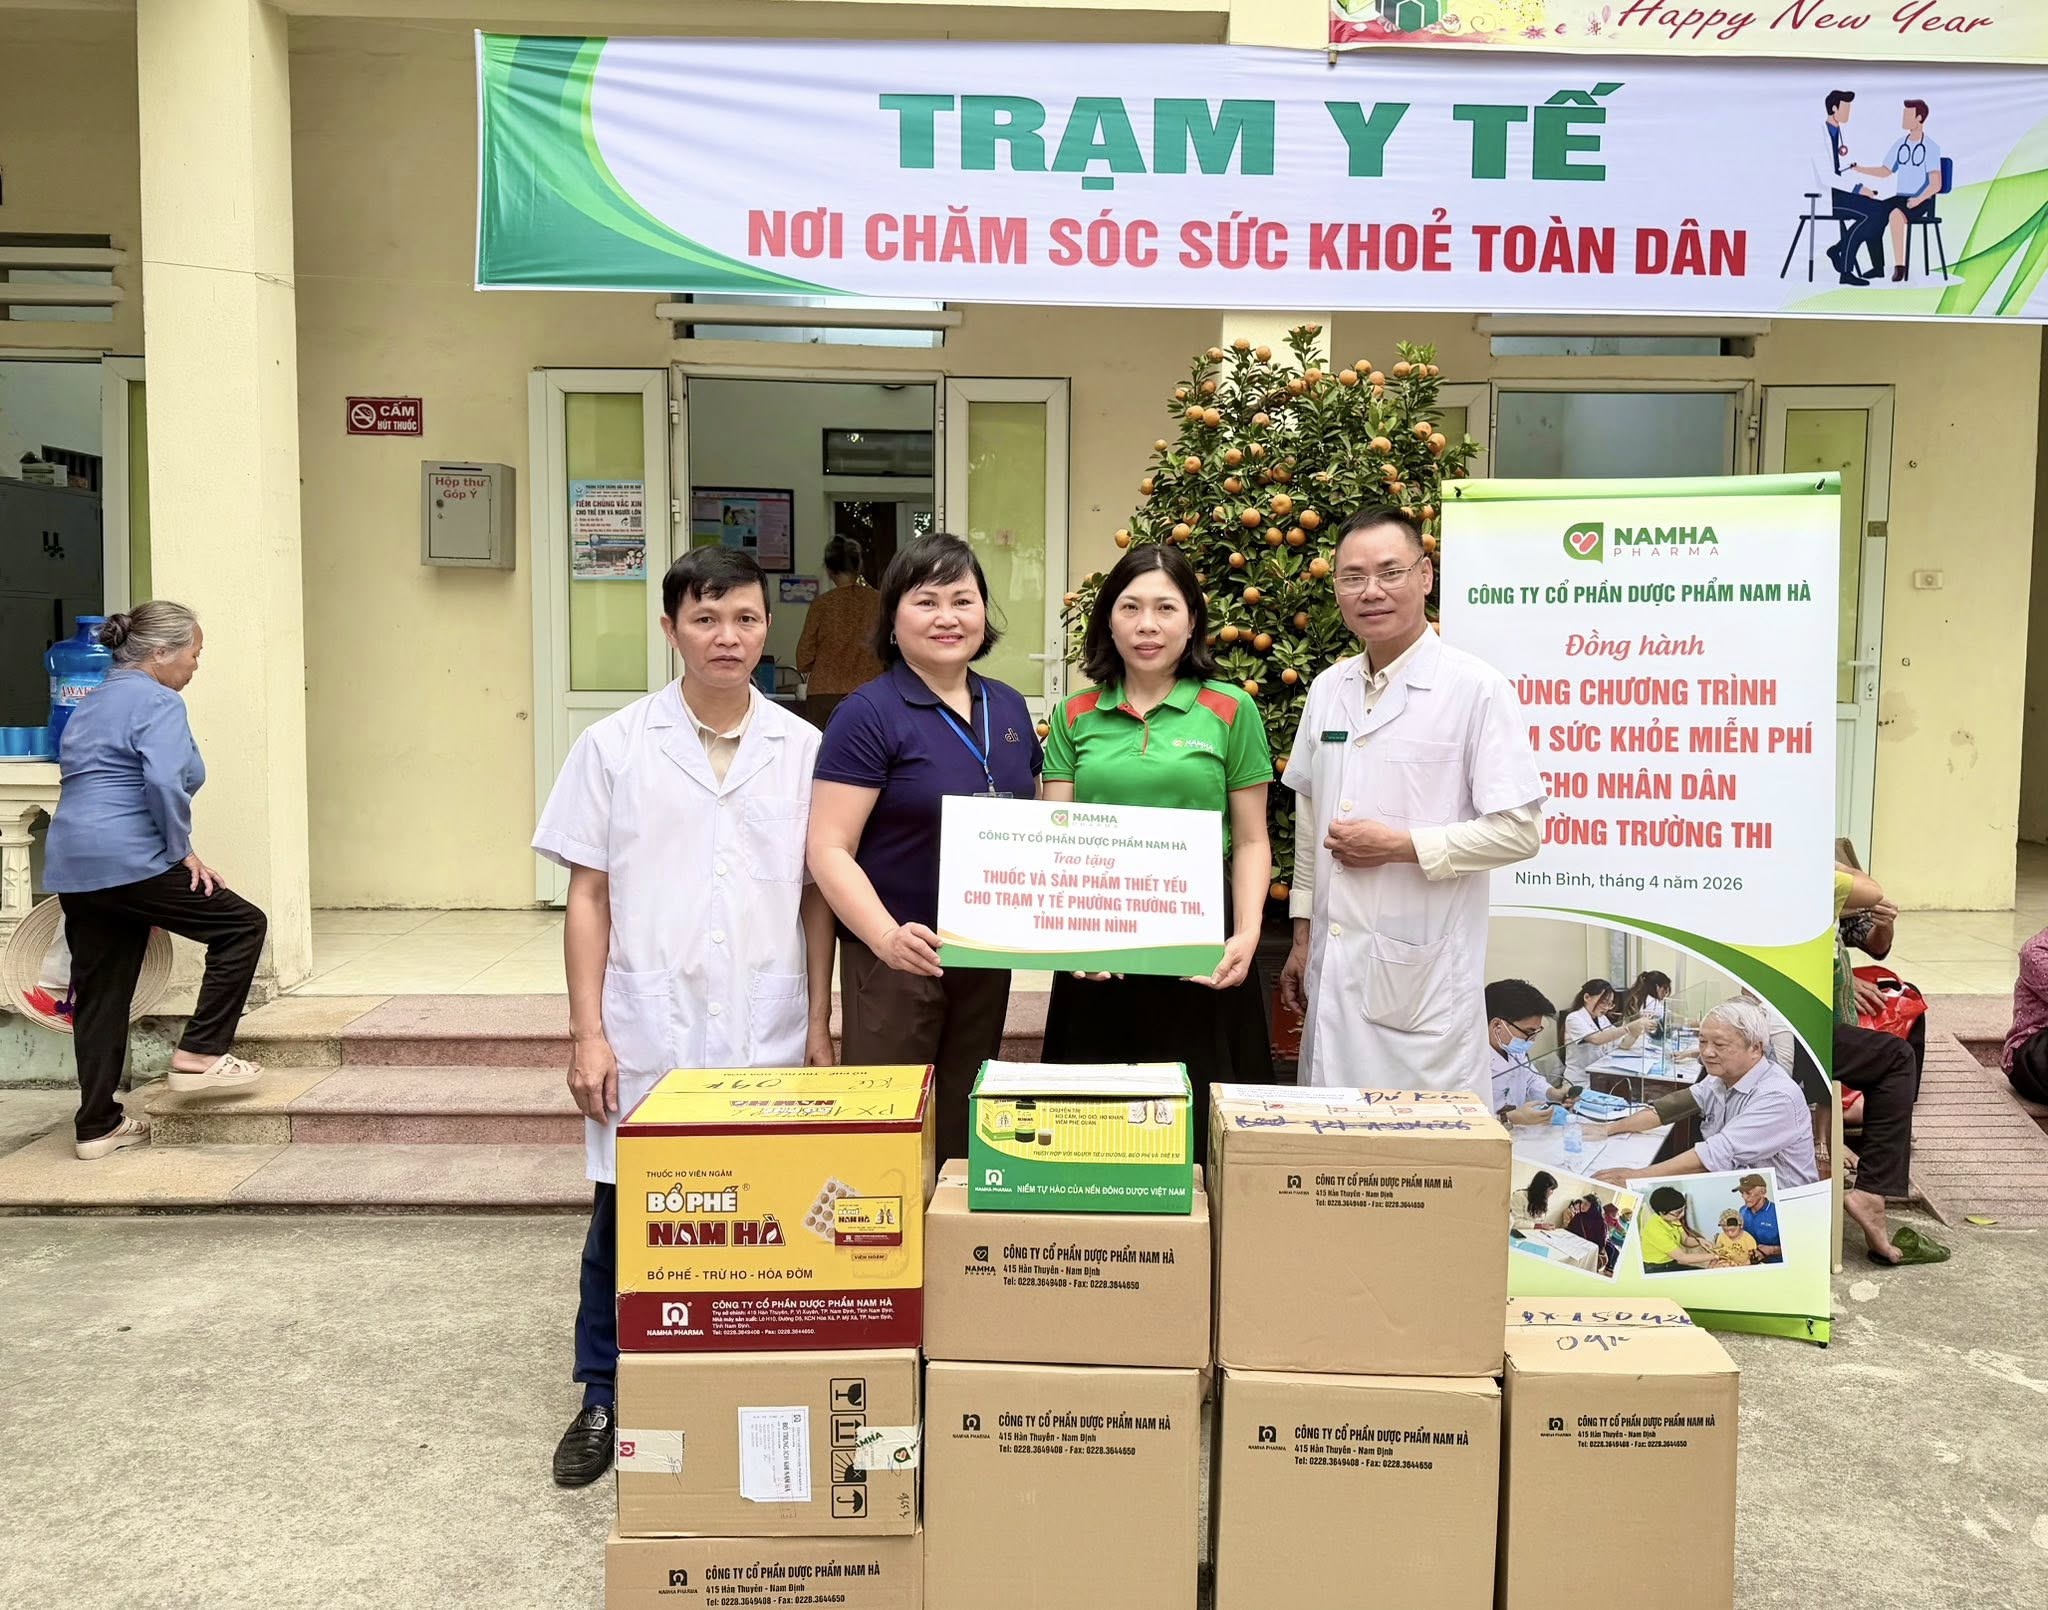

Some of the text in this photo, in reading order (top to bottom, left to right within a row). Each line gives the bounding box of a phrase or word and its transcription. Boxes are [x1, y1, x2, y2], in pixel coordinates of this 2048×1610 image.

[1617, 0, 1993, 40] Happy New Year
[879, 81, 1625, 190] TRẠM Y TẾ
[748, 206, 1746, 276] NƠI CHĂM SÓC SỨC KHOẺ TOÀN DÂN
[380, 401, 415, 417] CẤM
[377, 419, 419, 433] HÚT THUỐC
[435, 476, 486, 489] Hộp thư
[442, 488, 477, 500] Góp Ý
[1614, 526, 1718, 546] NAMHA
[1613, 546, 1719, 557] PHARMA
[1468, 576, 1811, 606] CÔNG TY CỔ PHẦN DƯỢC PHẨM NAM HÀ
[1565, 629, 1705, 661] Đồng hành
[1509, 673, 1776, 706] ÙNG CHƯƠNG TRÌNH
[1549, 719, 1601, 752] SỨC
[1610, 717, 1679, 753] KHỎE
[1689, 716, 1758, 753] MIỄN
[1768, 721, 1812, 754] PHÍ
[1597, 767, 1672, 800] NHÂN
[1681, 768, 1736, 800] DÂN
[1072, 812, 1118, 826] NAMHA
[1541, 811, 1772, 849] ƯỜNG TRƯỜNG THI
[1053, 851, 1116, 869] Trao tặng
[982, 867, 1187, 894] THUỐC VÀ SẢN PHẨM THIẾT YẾU
[1515, 871, 1743, 891] Ninh Bình, tháng 4 năm 2026
[964, 890, 1204, 917] CHO TRẠM Y TẾ PHƯỜNG TRƯỜNG THI,
[646, 1182, 739, 1213] BỔ PHẾ
[646, 1213, 786, 1247] NAM HÀ
[647, 1266, 664, 1280] BỔ
[667, 1267, 692, 1280] PHẾ
[702, 1268, 727, 1280] TRỪ
[730, 1270, 747, 1280] HO
[757, 1267, 783, 1279] HÓA
[786, 1266, 812, 1279] ĐỜM
[1003, 1264, 1017, 1273] 415
[1018, 1264, 1032, 1273] Hàn
[1034, 1264, 1059, 1275] Thuyên
[1066, 1268, 1082, 1276] Nam
[1084, 1266, 1101, 1278] Định
[1003, 1276, 1016, 1286] Tel:
[1017, 1277, 1067, 1287] 0228.3649408
[1073, 1279, 1088, 1288] Fax:
[1090, 1279, 1139, 1290] 0228.3644650
